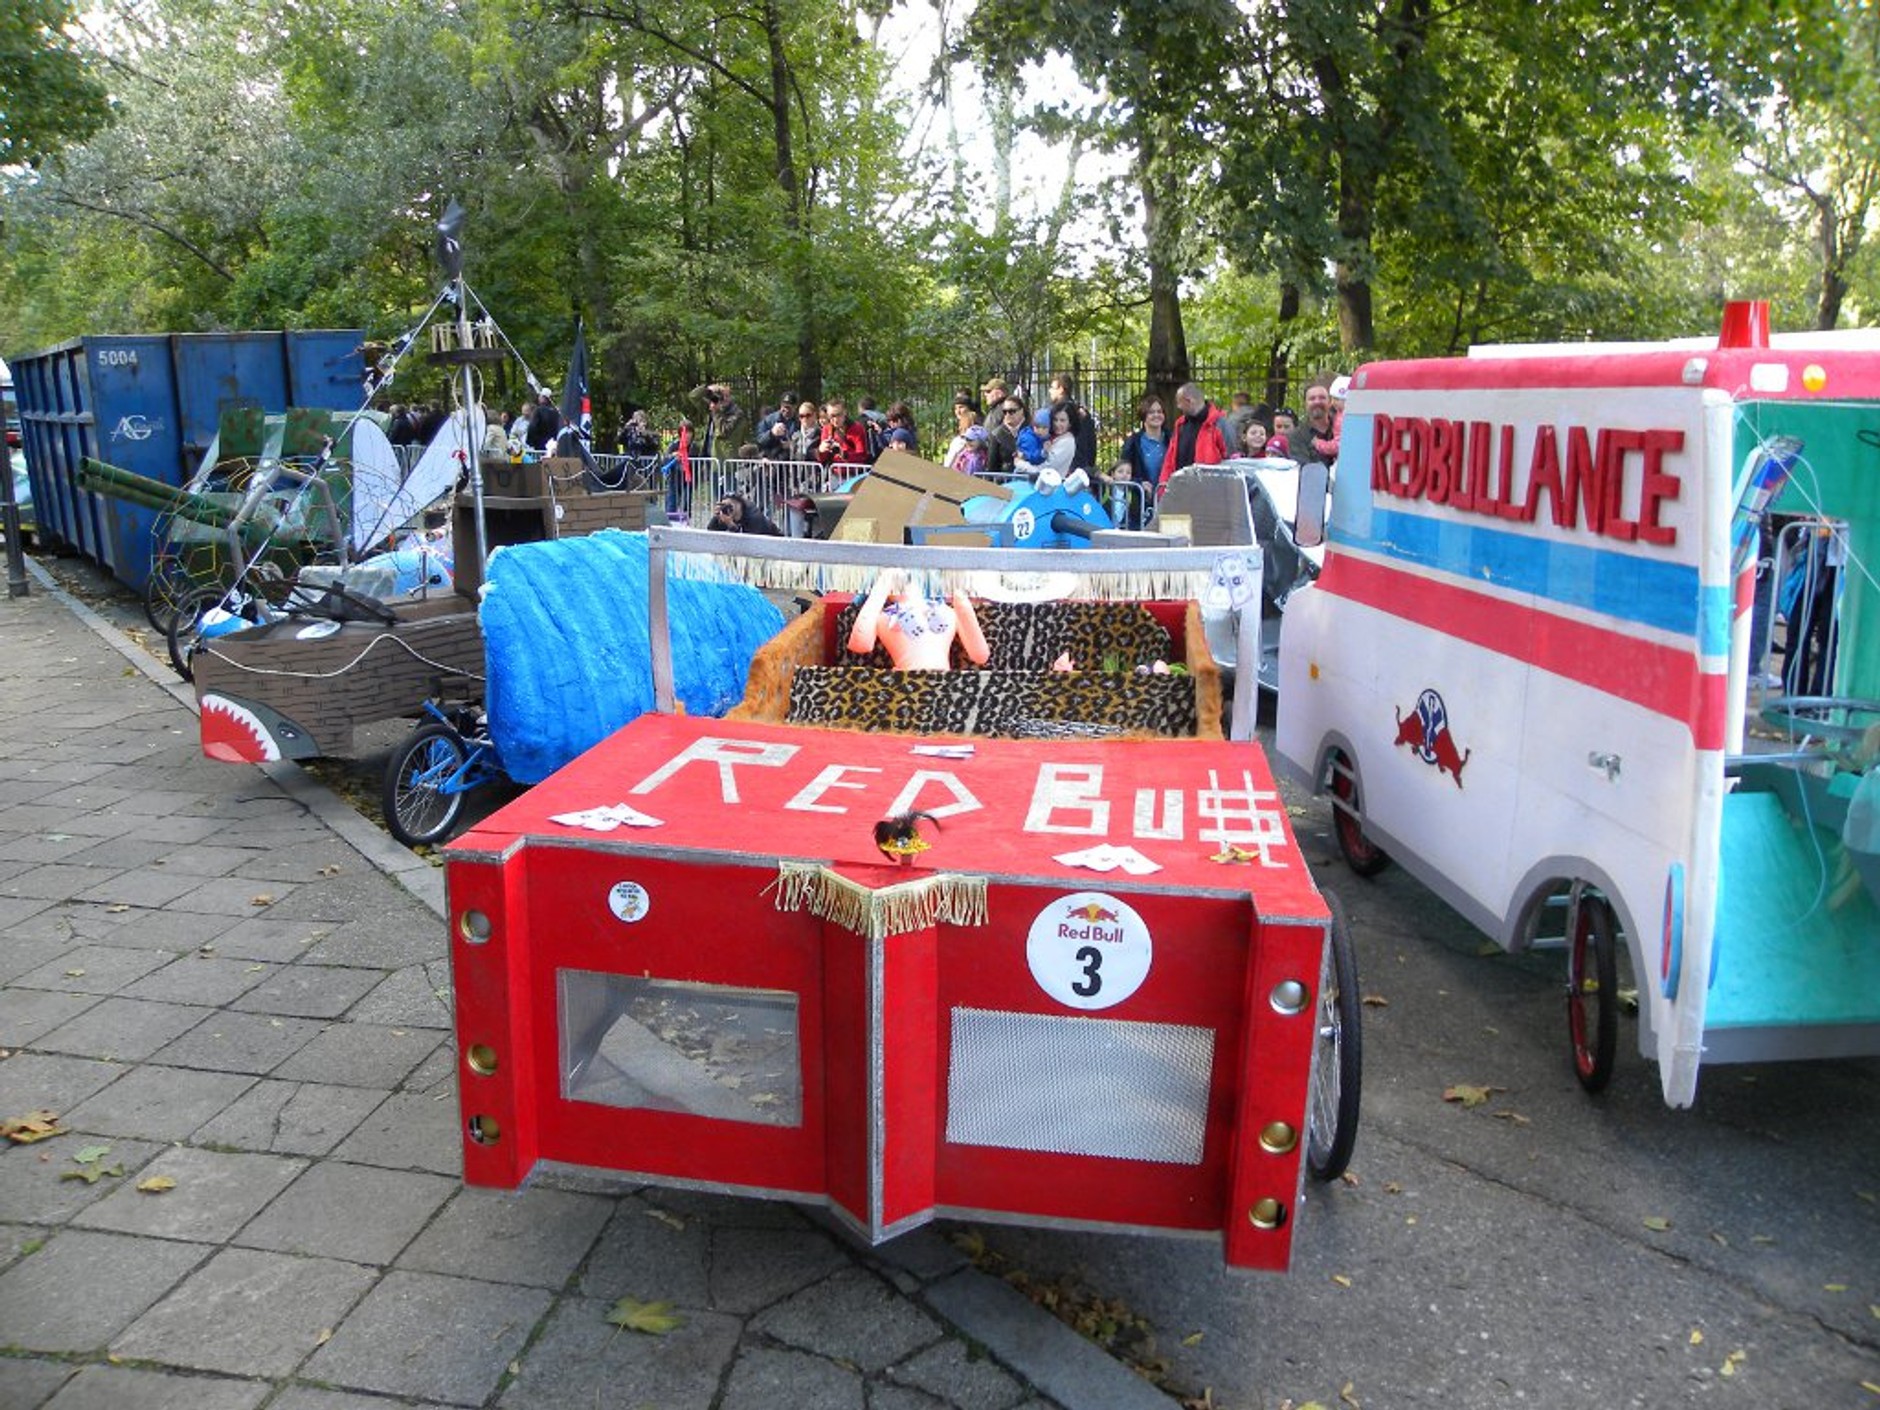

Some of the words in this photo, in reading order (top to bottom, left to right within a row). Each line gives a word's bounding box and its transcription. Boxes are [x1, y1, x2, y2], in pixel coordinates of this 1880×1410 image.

[98, 350, 138, 367] 5004
[1369, 412, 1686, 547] REDBULLANCE
[1057, 923, 1090, 940] Red
[1092, 925, 1124, 943] Bull
[1071, 945, 1103, 998] 3
